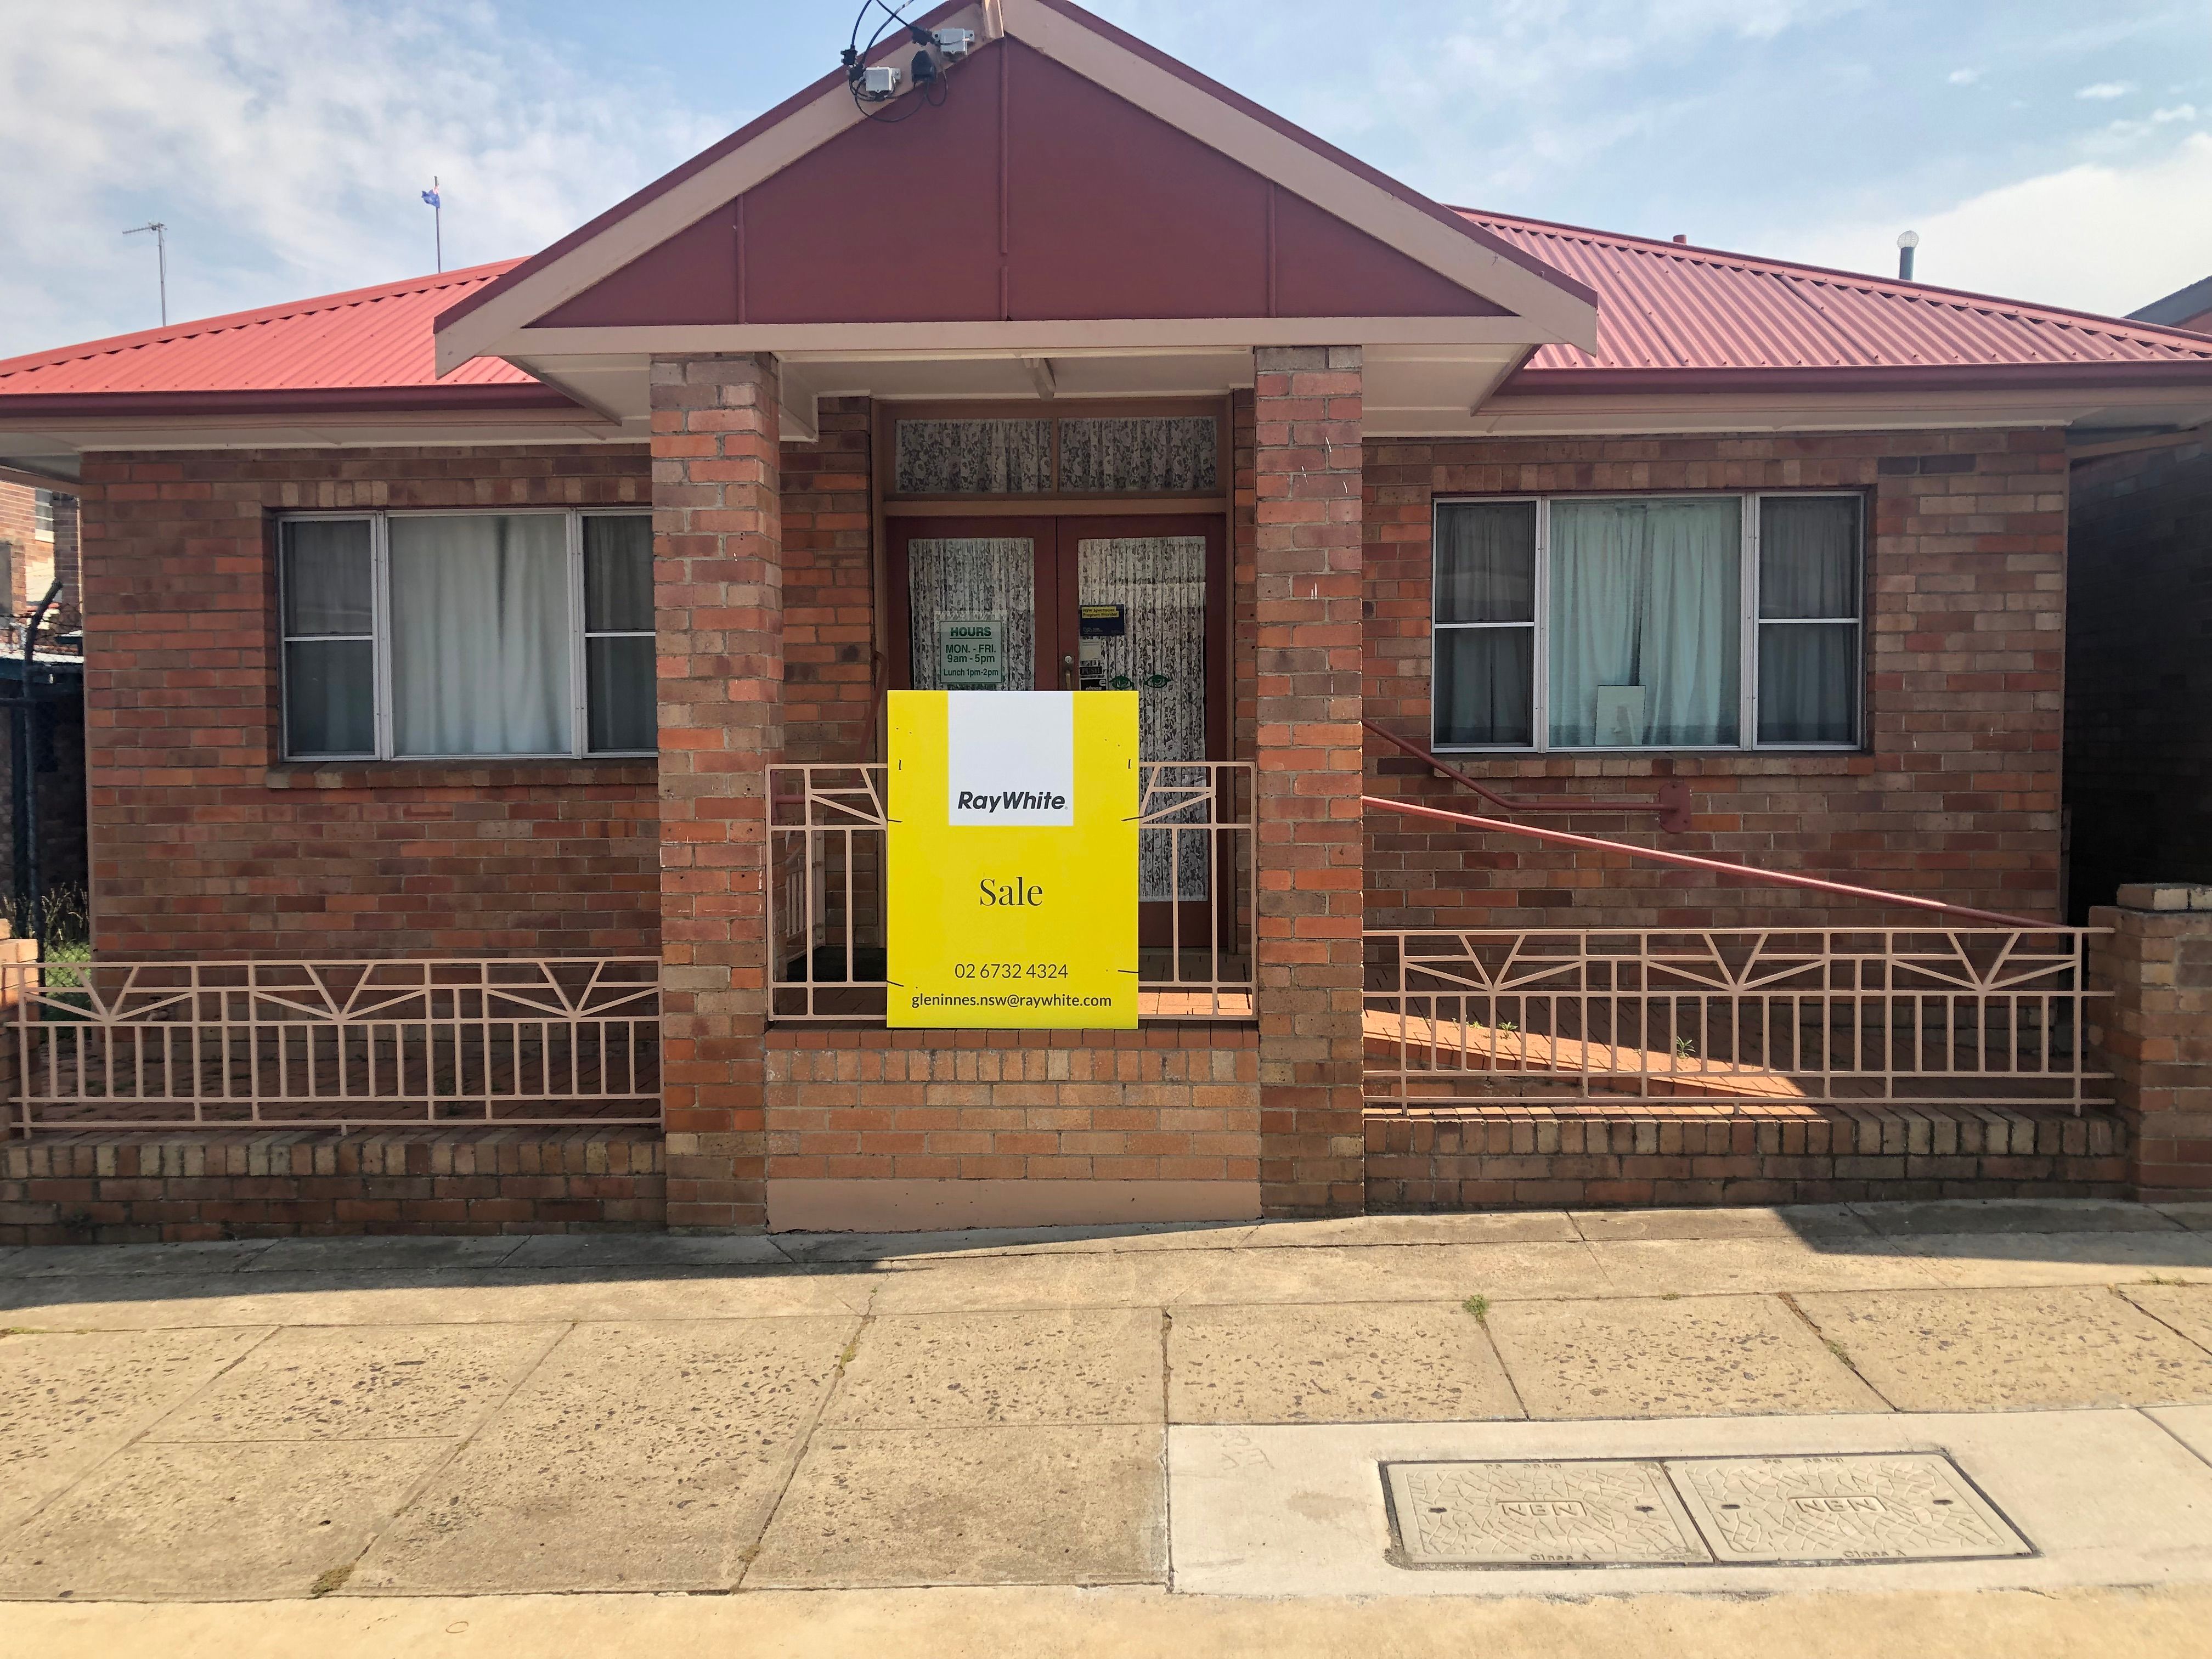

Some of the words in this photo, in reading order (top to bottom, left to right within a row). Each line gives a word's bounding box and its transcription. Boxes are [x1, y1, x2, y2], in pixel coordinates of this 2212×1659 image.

[950, 627, 991, 637] HOURS
[945, 644, 970, 653] MON.
[978, 644, 996, 653] FRI.
[947, 654, 967, 663] 9am
[974, 653, 995, 665] 5pm
[966, 668, 998, 678] 1pm-2pm
[980, 876, 1043, 906] Sale
[955, 963, 975, 979] 02
[979, 963, 1022, 979] 6732
[1025, 963, 1069, 979] 4324
[911, 993, 1111, 1009] gleninnes.nsw@raywhite.com
[1502, 1504, 1578, 1516] NBN
[1795, 1498, 1877, 1513] NBN
